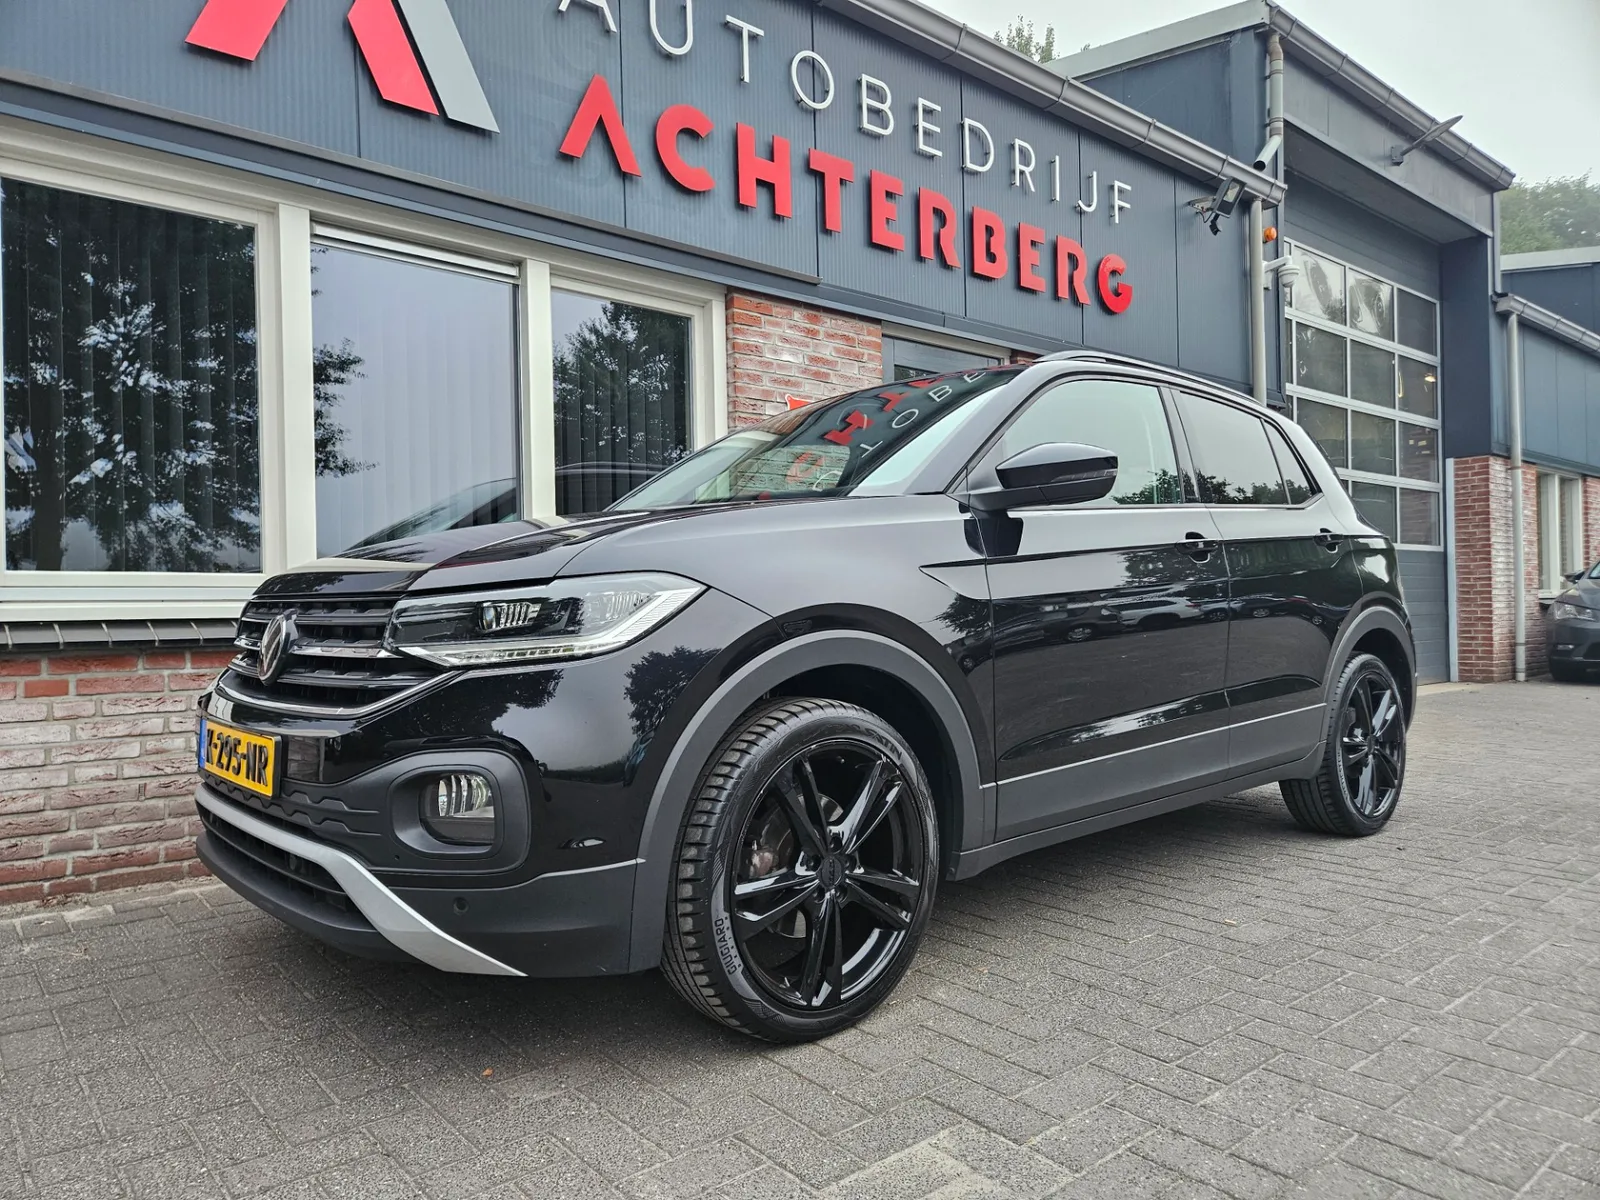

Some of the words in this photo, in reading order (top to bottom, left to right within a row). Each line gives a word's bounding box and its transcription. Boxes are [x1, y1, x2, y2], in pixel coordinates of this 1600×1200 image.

[559, 74, 1133, 313] ACHTERBERG
[207, 729, 268, 787] K-295-NR
[714, 918, 737, 975] GIUGIARO
